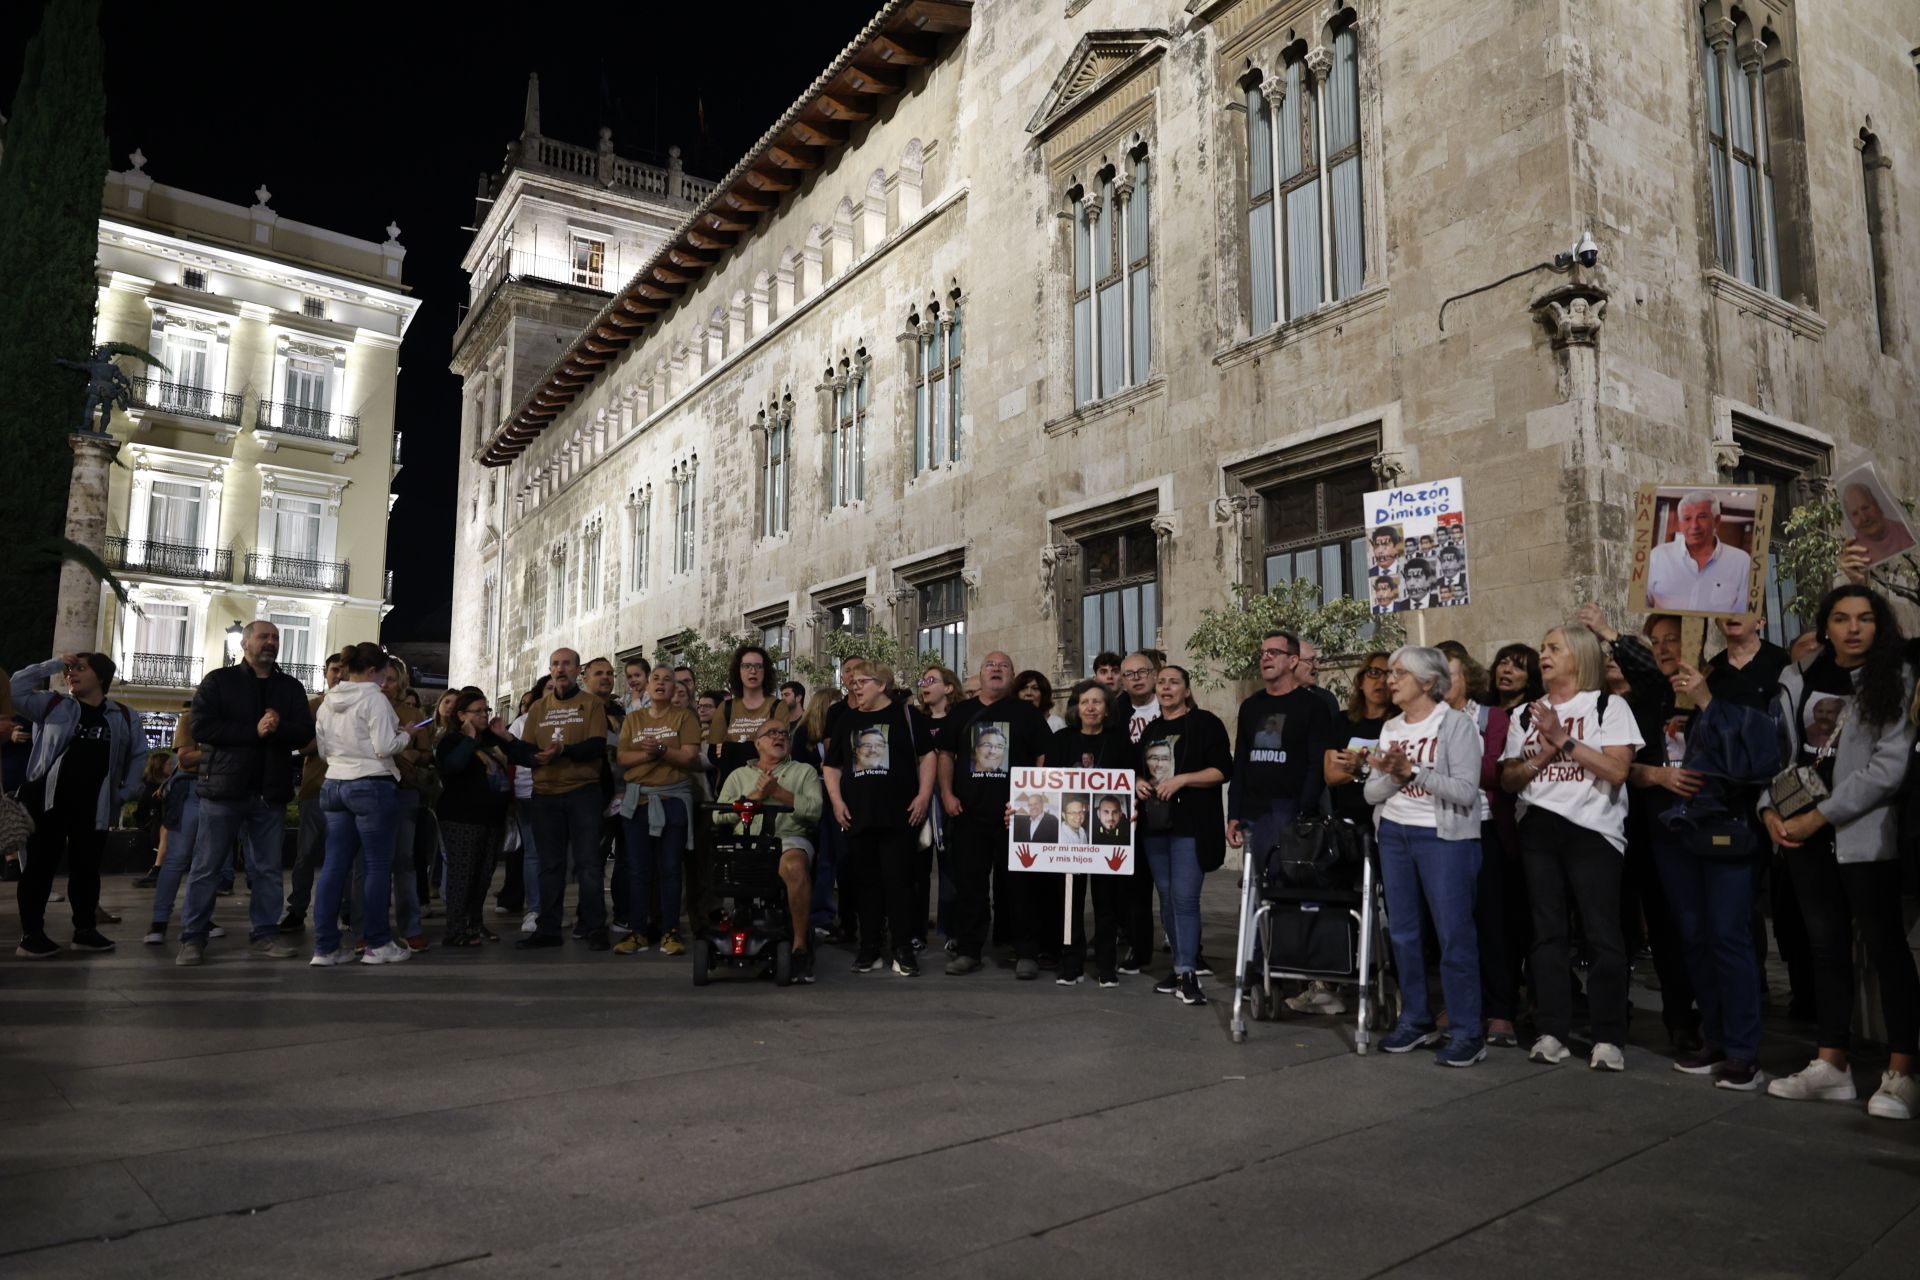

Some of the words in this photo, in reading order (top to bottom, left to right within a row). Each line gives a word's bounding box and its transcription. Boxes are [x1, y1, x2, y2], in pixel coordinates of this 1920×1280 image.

[1375, 498, 1450, 525] Dimissió
[985, 771, 1007, 779] Vicente
[1014, 770, 1131, 791] JUSTICIA
[1042, 845, 1056, 853] por
[1073, 855, 1093, 864] hijos
